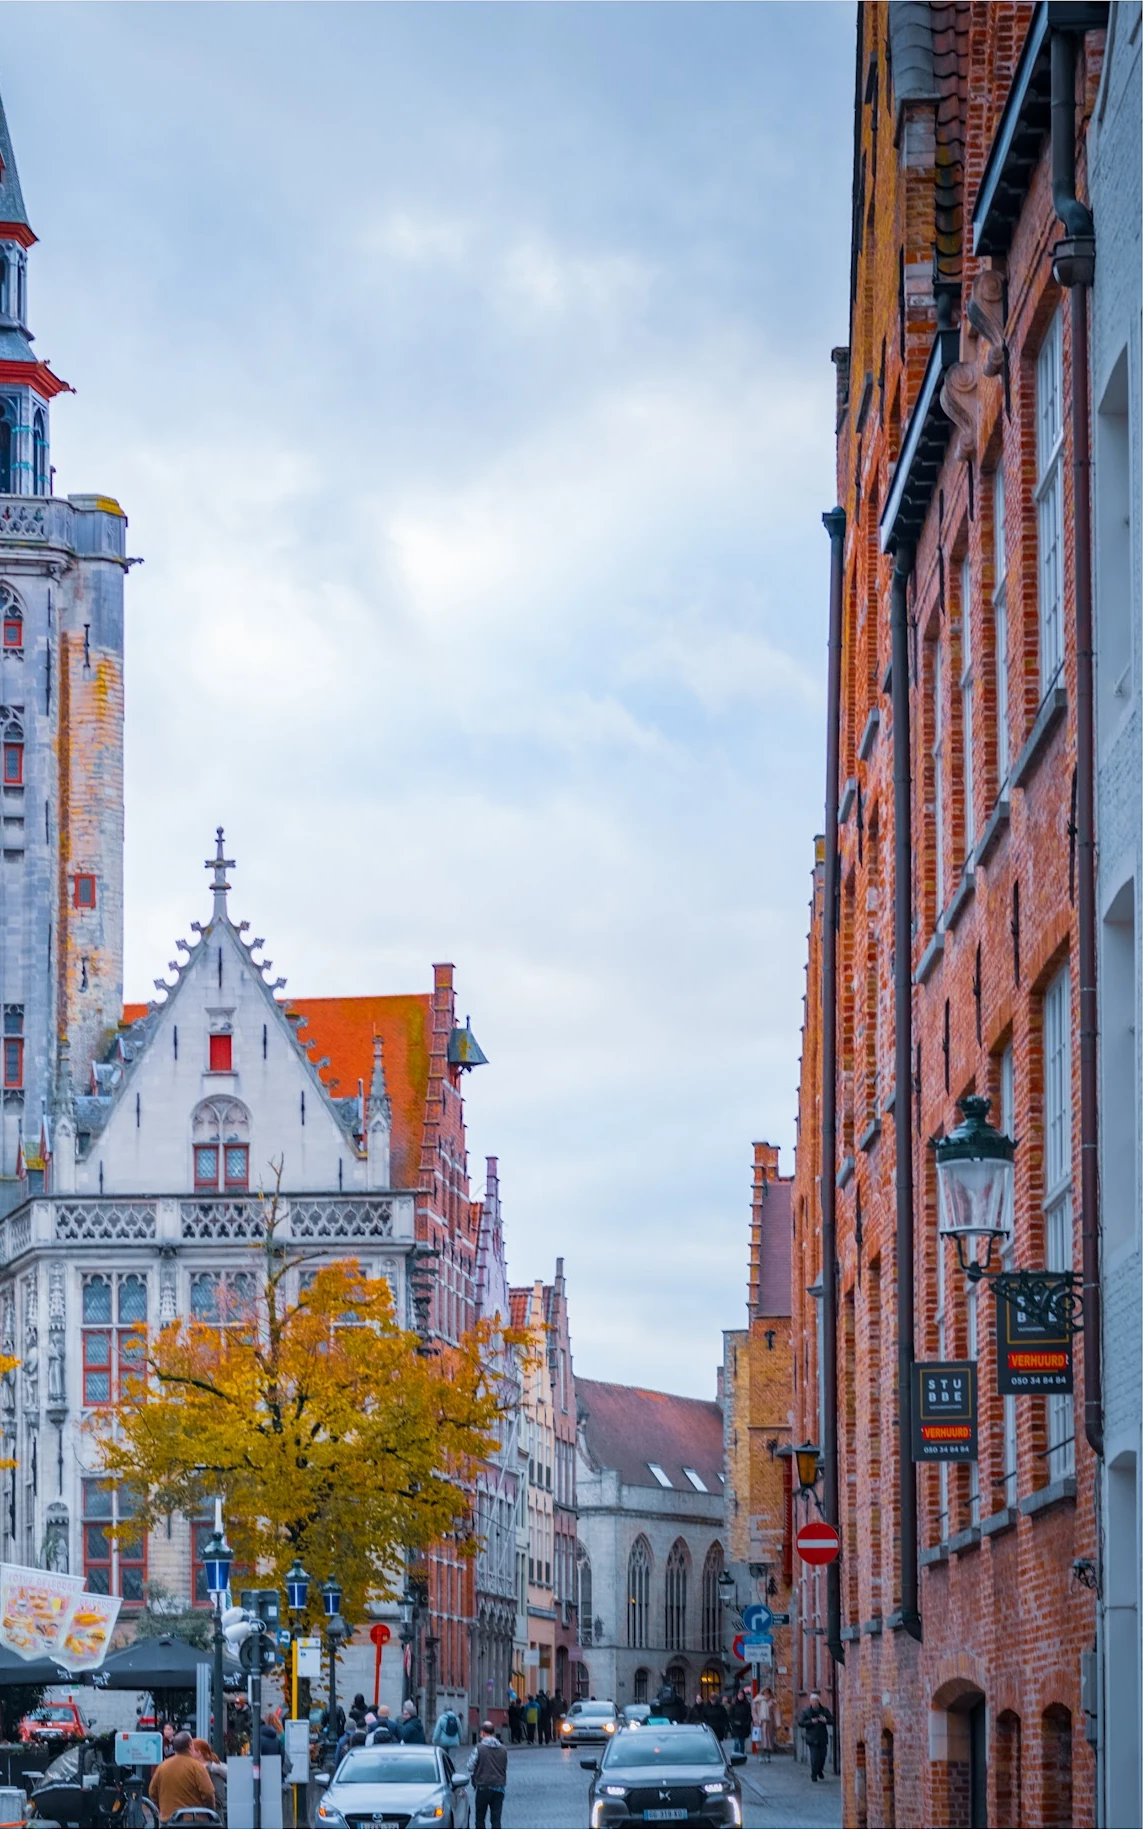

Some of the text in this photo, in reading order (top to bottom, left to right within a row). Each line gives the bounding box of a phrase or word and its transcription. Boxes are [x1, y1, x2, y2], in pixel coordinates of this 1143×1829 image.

[1011, 1354, 1065, 1367] VERHUURD
[1011, 1376, 1067, 1386] 050 34 84 84
[925, 1427, 969, 1438] VERHUURD
[923, 1446, 938, 1454] 050
